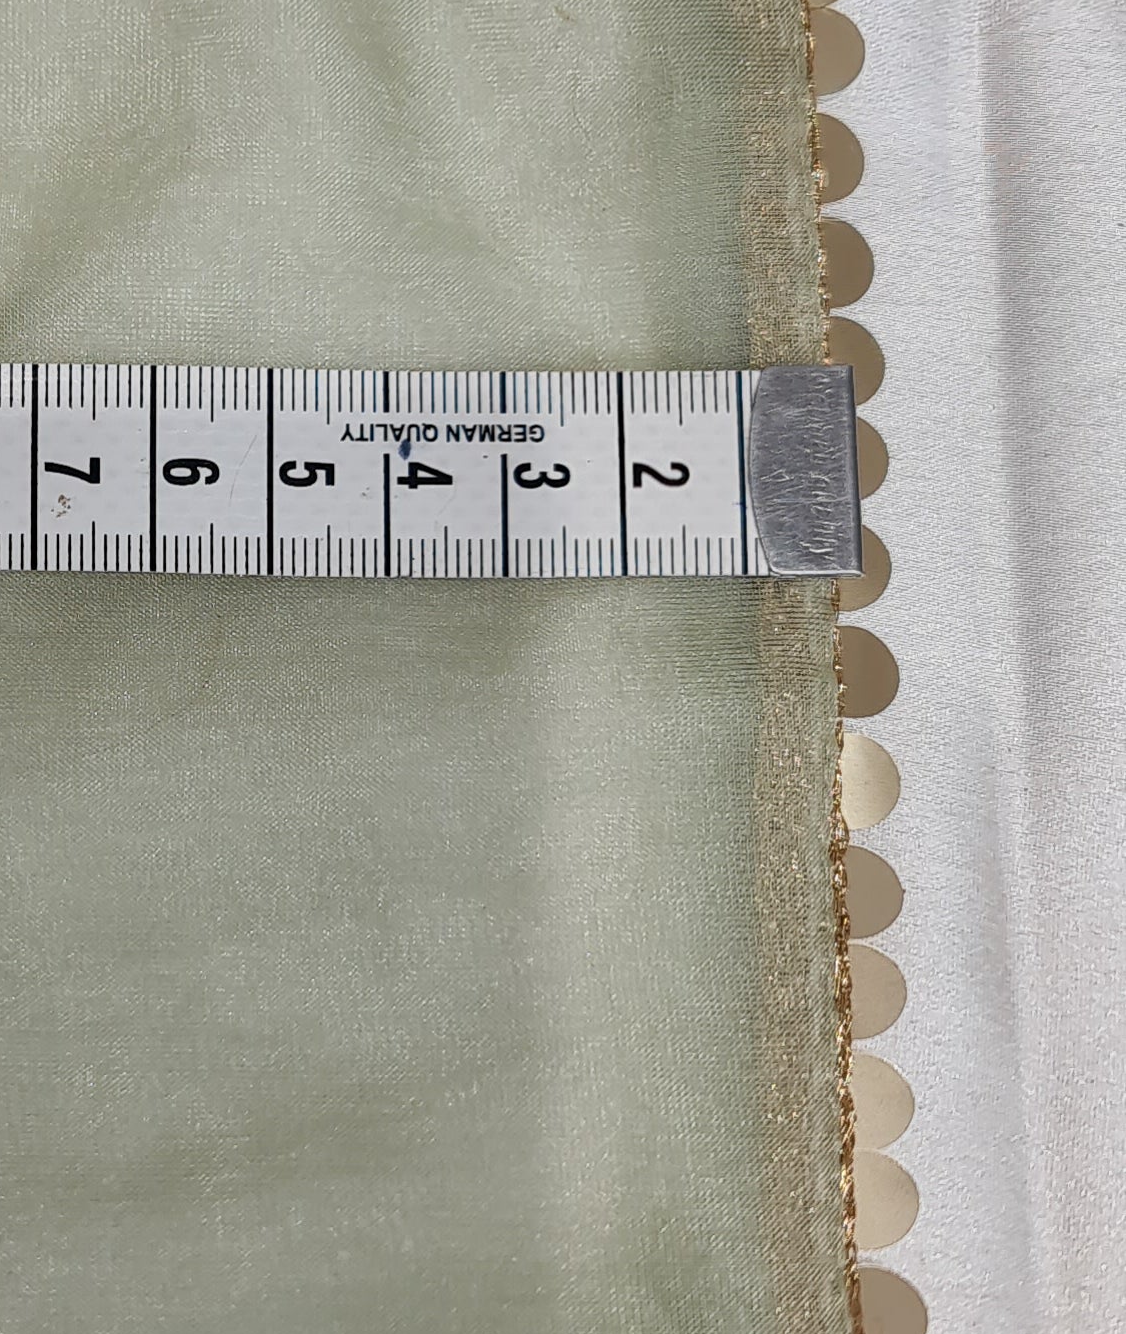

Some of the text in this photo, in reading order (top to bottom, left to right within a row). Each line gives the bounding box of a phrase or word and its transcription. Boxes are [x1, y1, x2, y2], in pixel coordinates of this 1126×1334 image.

[340, 422, 546, 445] GERMAN QUALITY
[44, 457, 101, 484] 7
[162, 458, 220, 486] 6
[278, 460, 335, 488] 5
[396, 461, 453, 490] 4
[513, 462, 571, 489] 3
[632, 462, 690, 488] 2
